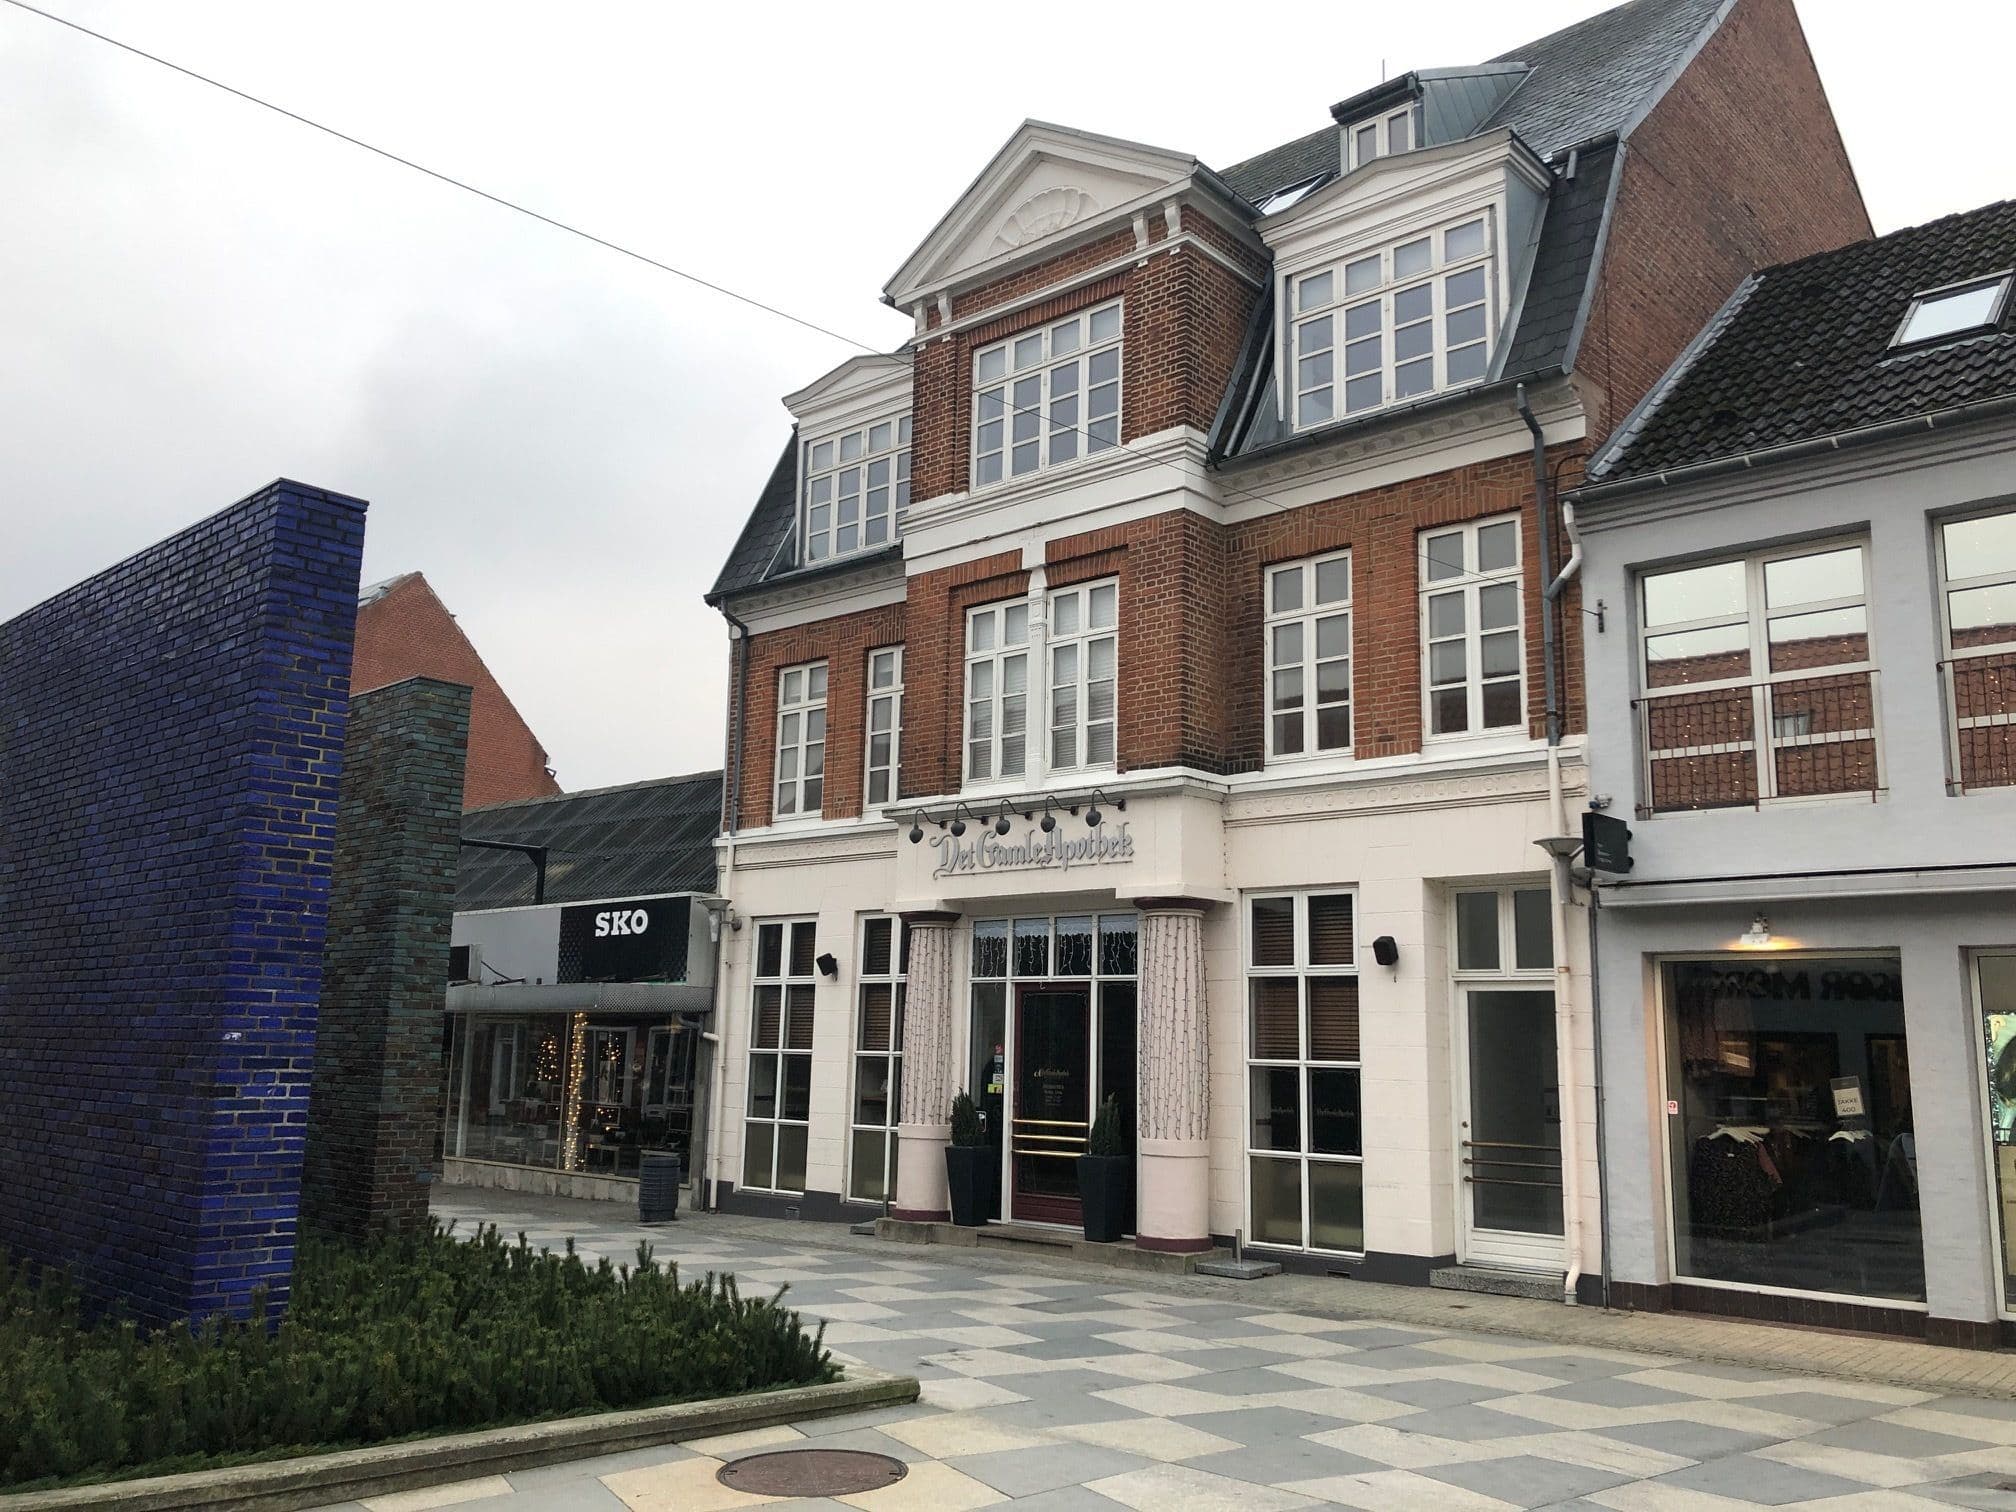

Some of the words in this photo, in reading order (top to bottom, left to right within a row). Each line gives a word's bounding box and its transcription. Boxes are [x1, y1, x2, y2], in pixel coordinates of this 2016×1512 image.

[929, 834, 976, 878] Det
[976, 829, 1043, 868] Gamle
[595, 908, 649, 937] SKO
